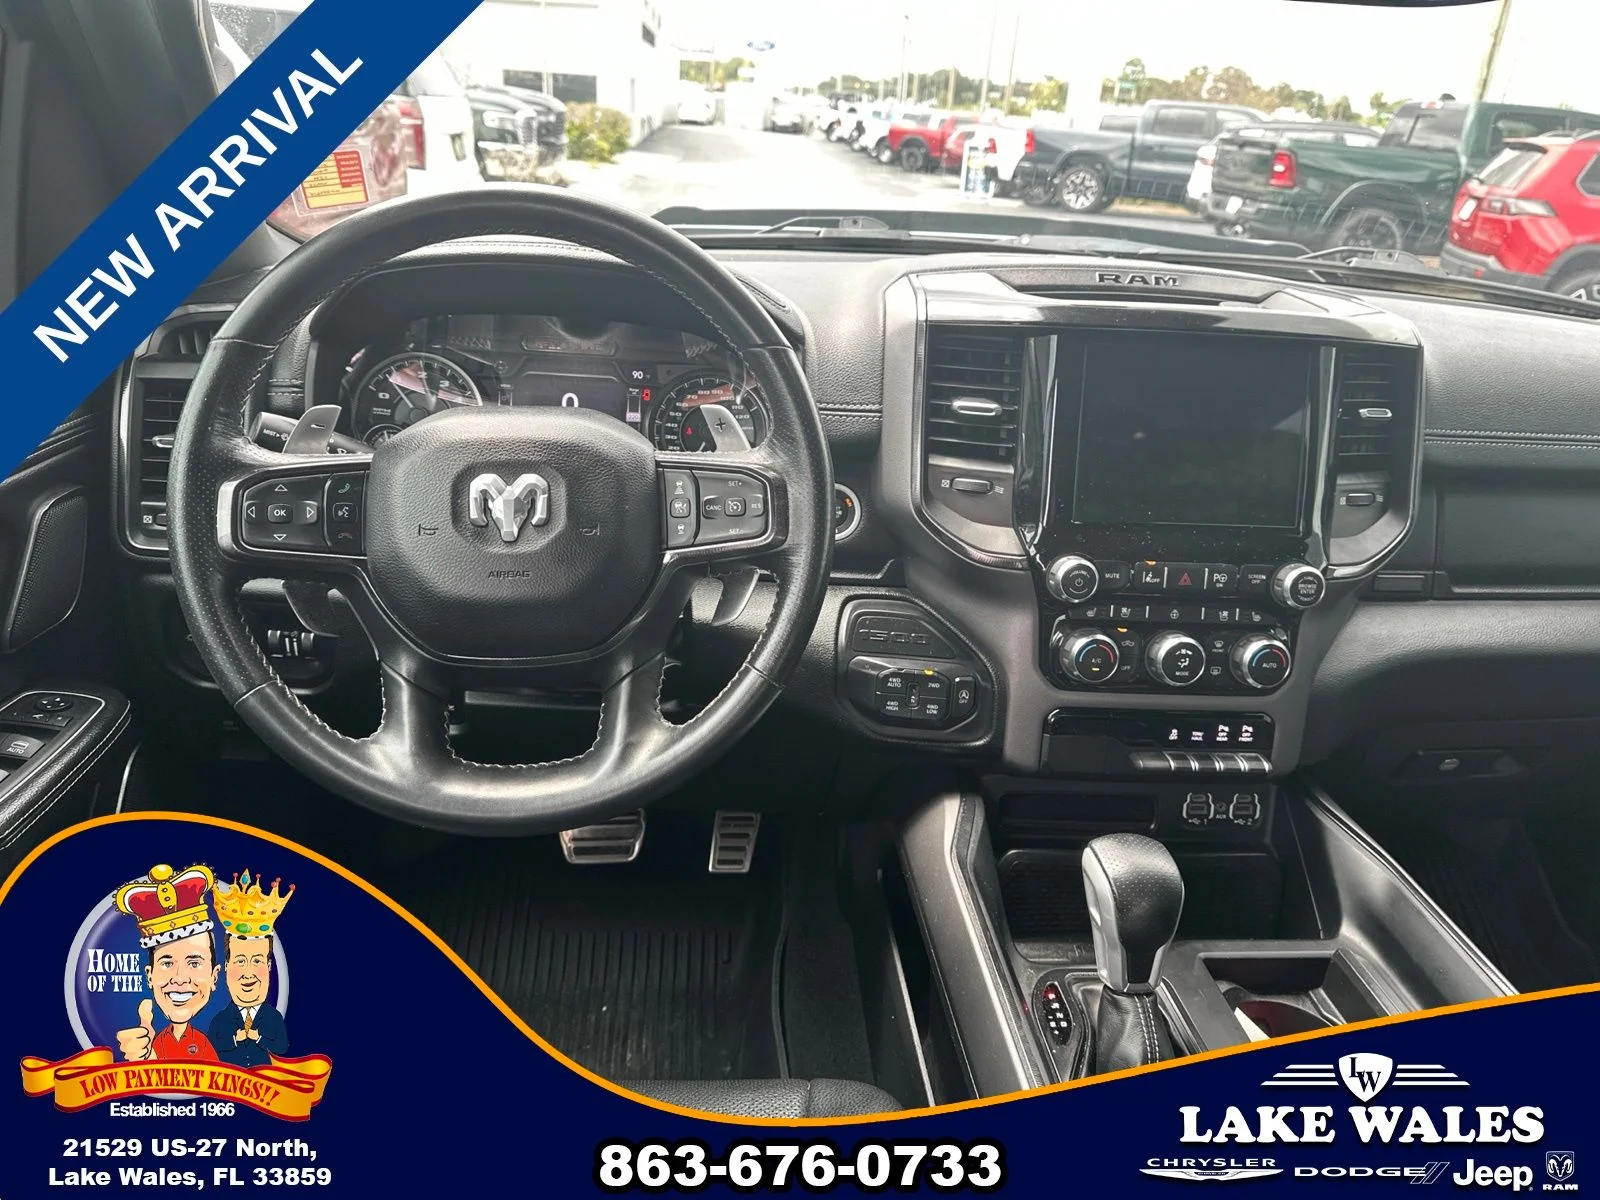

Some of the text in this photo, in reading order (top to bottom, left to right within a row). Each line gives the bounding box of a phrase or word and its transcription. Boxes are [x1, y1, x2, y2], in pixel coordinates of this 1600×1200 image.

[1096, 272, 1179, 286] RAM
[632, 370, 643, 379] 90
[273, 509, 286, 517] OK
[488, 570, 530, 578] AIRBAG
